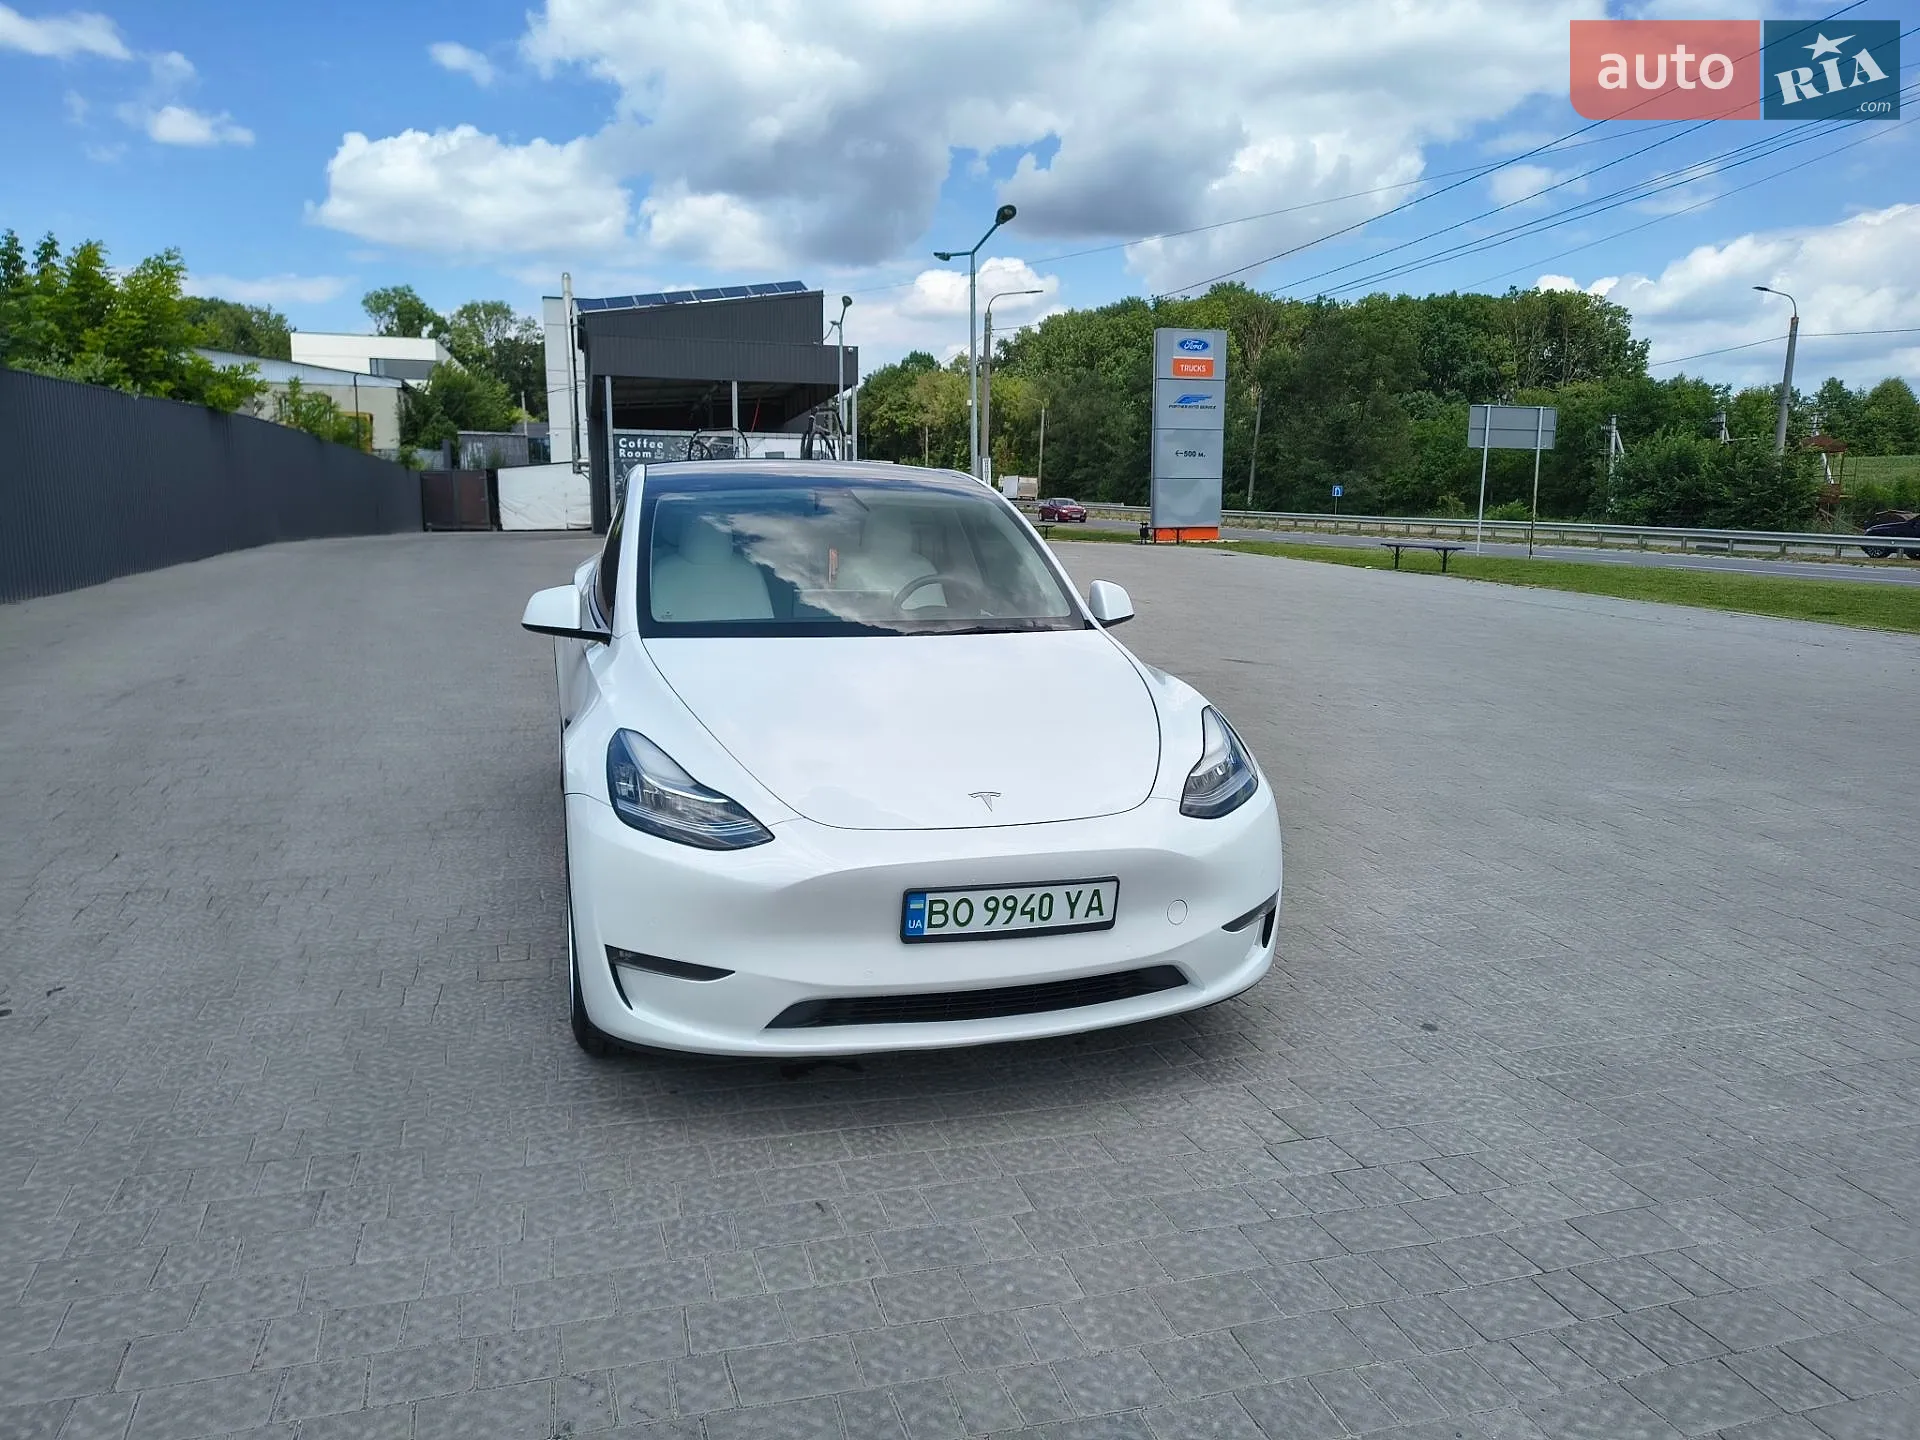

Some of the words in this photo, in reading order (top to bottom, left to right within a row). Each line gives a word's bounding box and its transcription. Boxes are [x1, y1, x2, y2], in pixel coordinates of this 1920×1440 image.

[1183, 340, 1204, 350] Ford
[1180, 364, 1206, 373] TRUCKS
[618, 437, 664, 449] Coffee
[618, 448, 652, 458] Room
[926, 897, 975, 929] BO
[983, 892, 1055, 926] 9940
[1065, 888, 1105, 920] YA
[908, 919, 923, 929] UA
